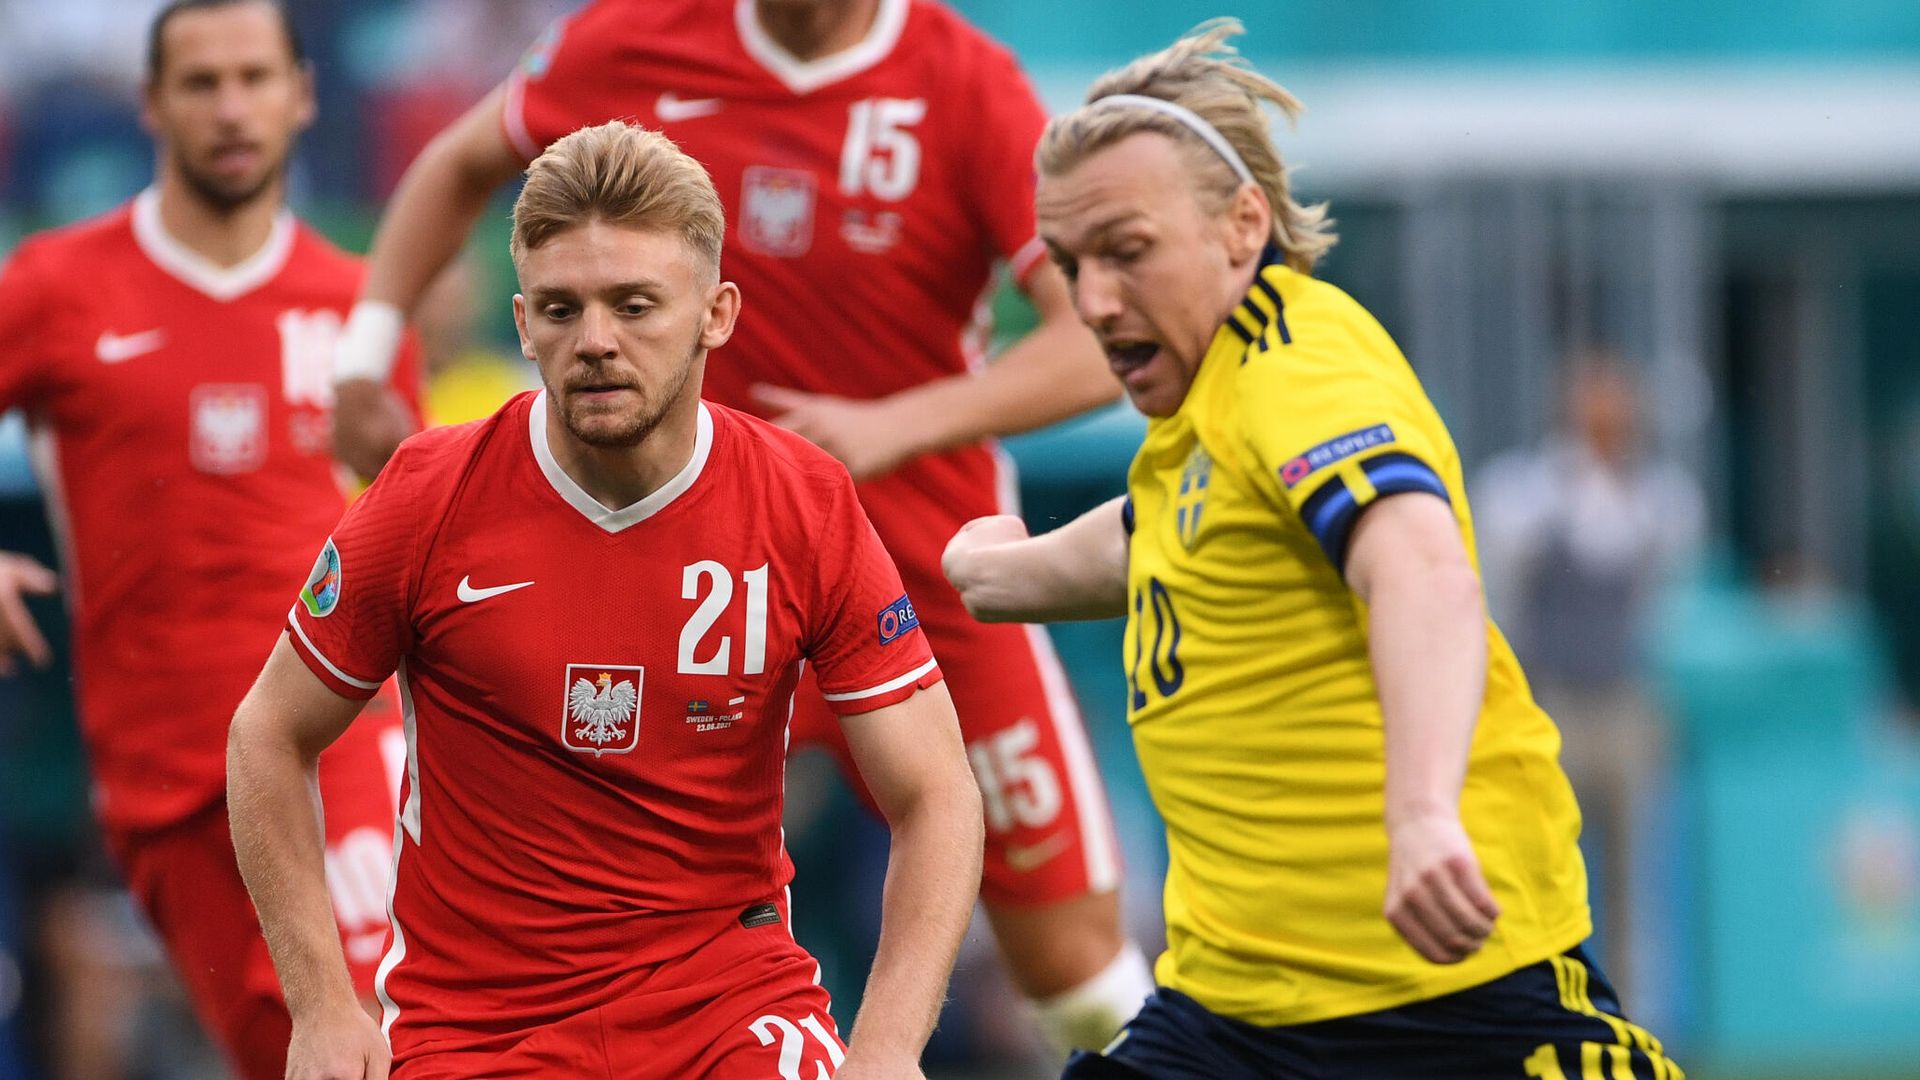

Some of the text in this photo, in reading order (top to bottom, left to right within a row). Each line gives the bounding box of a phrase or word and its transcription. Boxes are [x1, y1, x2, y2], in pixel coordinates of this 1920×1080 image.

[839, 97, 928, 203] 15
[1307, 425, 1392, 464] RESPECT
[677, 560, 768, 676] 21
[1131, 576, 1185, 712] 10
[686, 715, 715, 724] SWEDEN
[719, 711, 743, 723] POLAND
[969, 718, 1061, 832] 15
[747, 1012, 846, 1080] 21
